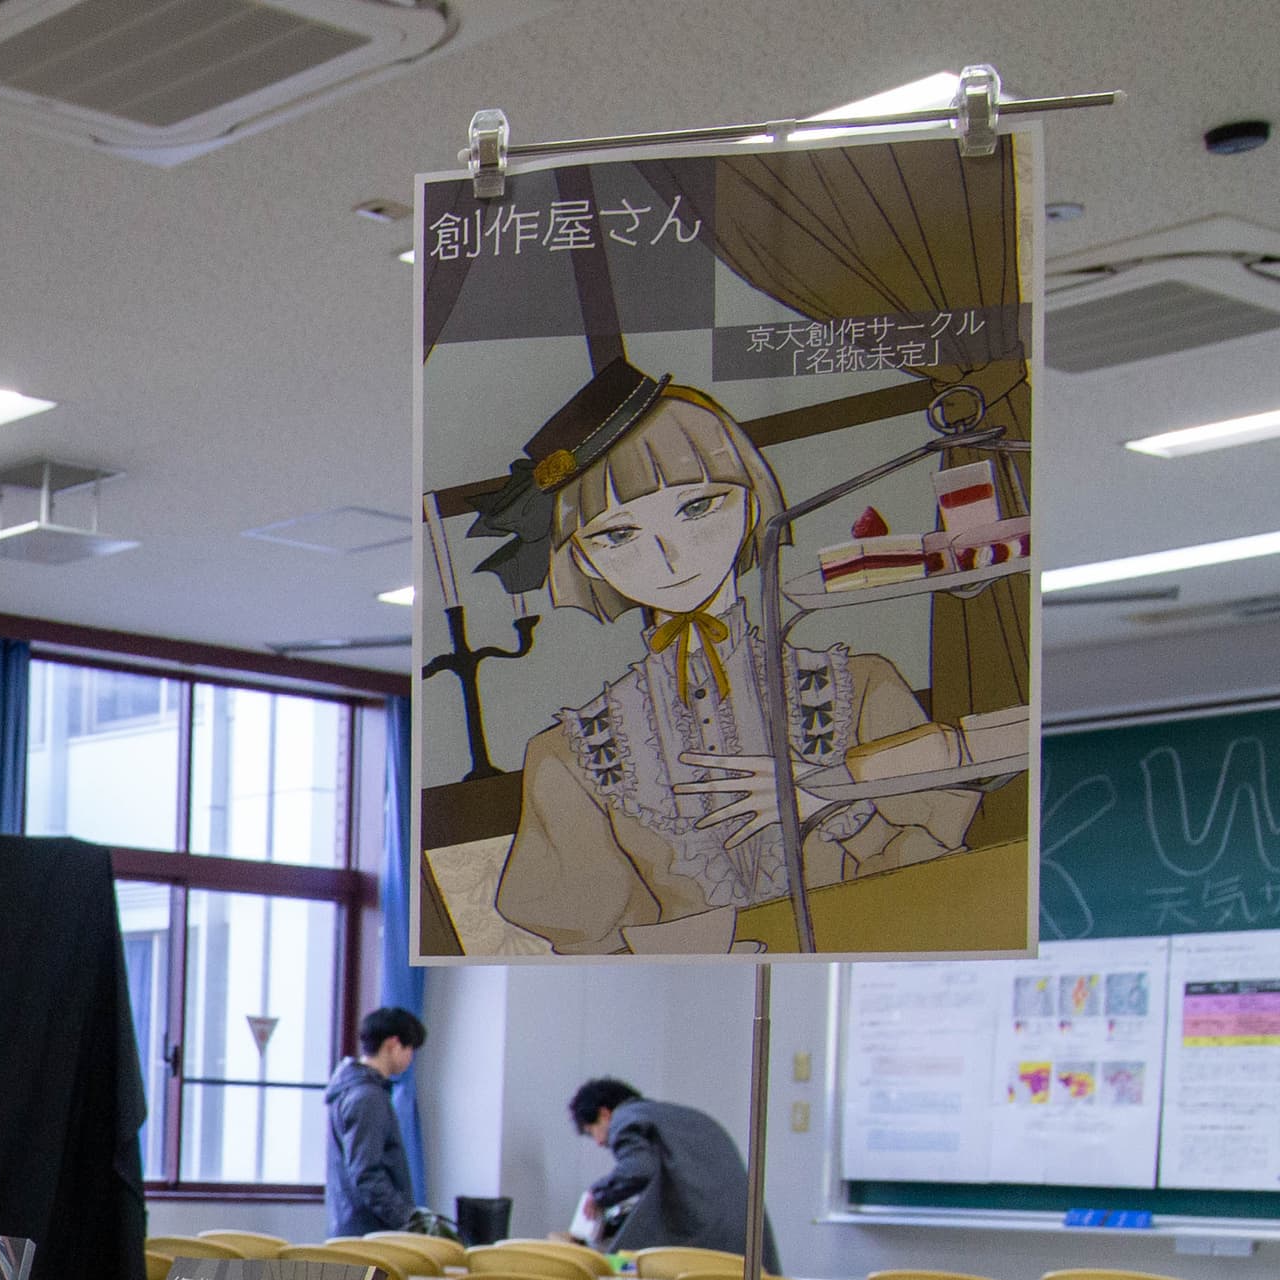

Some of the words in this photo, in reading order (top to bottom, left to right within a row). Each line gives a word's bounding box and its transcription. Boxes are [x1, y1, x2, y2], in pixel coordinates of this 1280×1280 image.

[429, 196, 702, 262] 創作屋さん
[746, 310, 986, 353] 京大創作サークル
[792, 340, 941, 376] 「名称未定」
